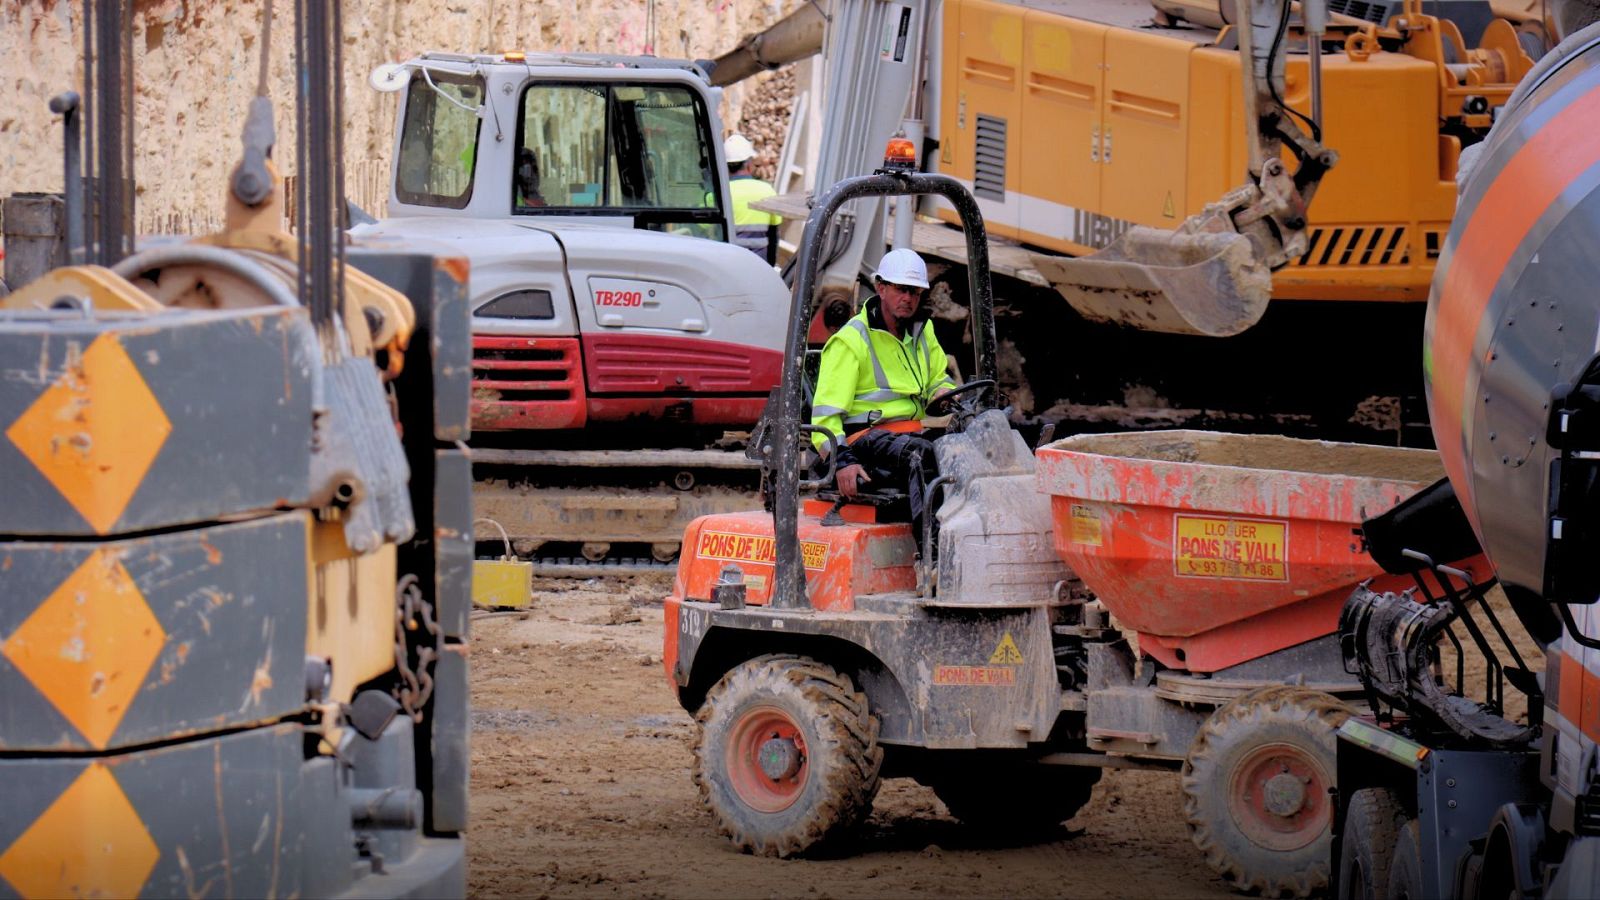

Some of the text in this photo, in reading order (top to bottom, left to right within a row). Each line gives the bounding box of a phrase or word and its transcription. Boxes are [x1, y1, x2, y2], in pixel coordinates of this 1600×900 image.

[1074, 208, 1137, 249] LIEBH
[595, 291, 642, 307] TB290
[701, 534, 776, 561] PONS DE VAL
[1181, 537, 1281, 564] PONS DE VALL
[1203, 561, 1217, 573] 93
[939, 667, 968, 682] PONS
[970, 667, 984, 682] DE
